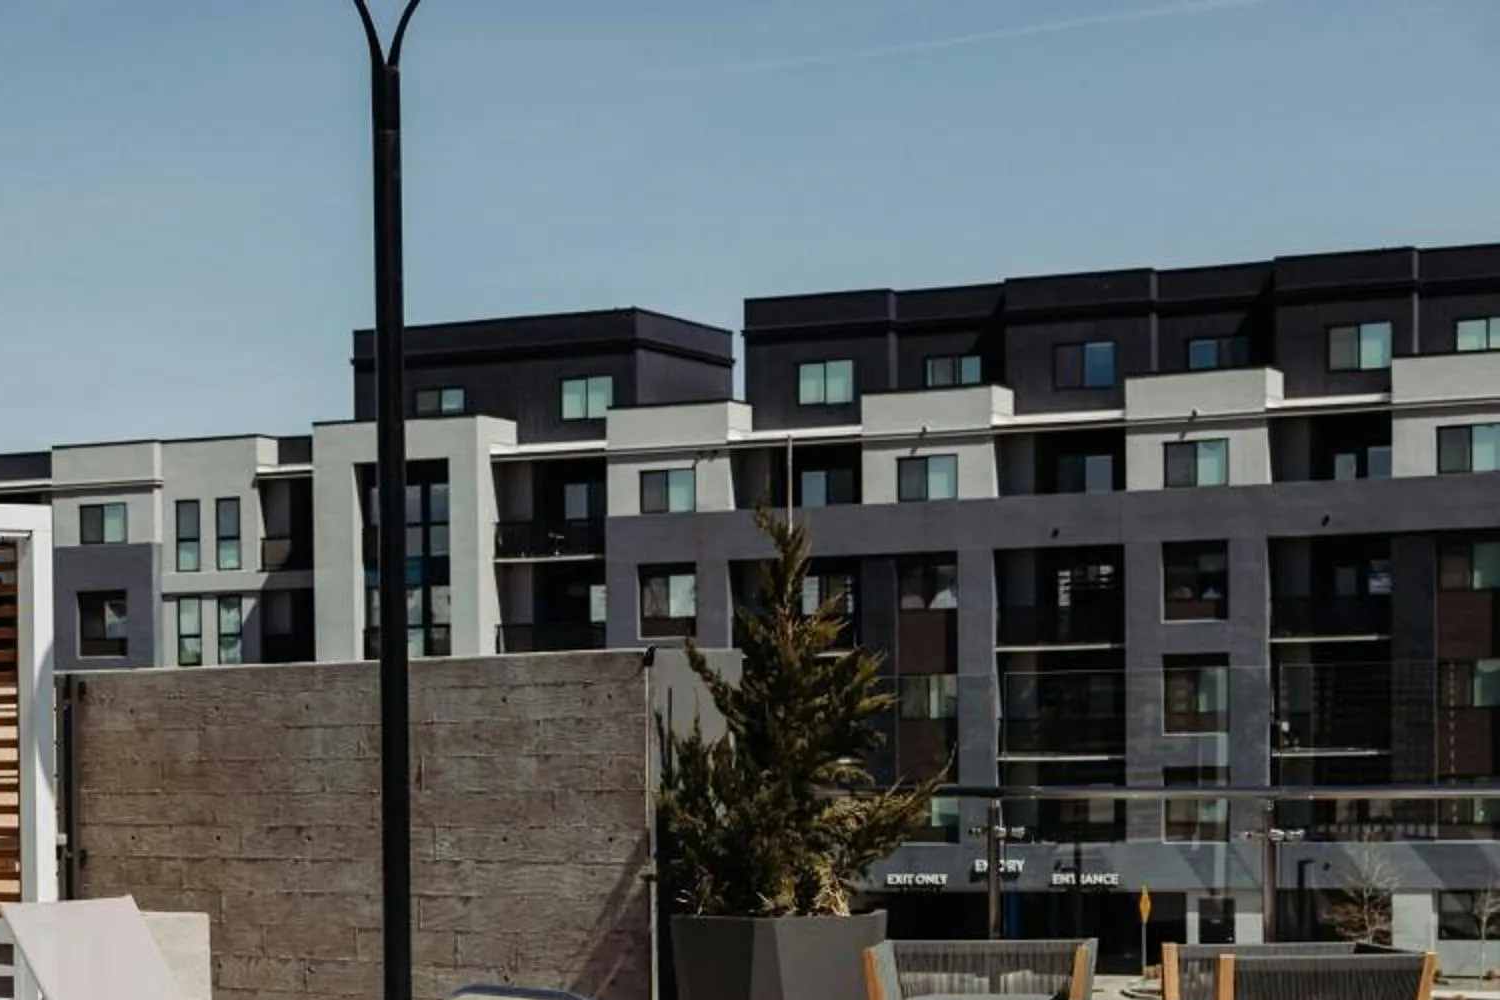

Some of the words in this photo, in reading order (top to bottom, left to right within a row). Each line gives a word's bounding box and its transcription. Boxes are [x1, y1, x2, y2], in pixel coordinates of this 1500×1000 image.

[975, 859, 1025, 872] ERY
[887, 873, 914, 885] EXIT
[915, 873, 946, 885] ONLY
